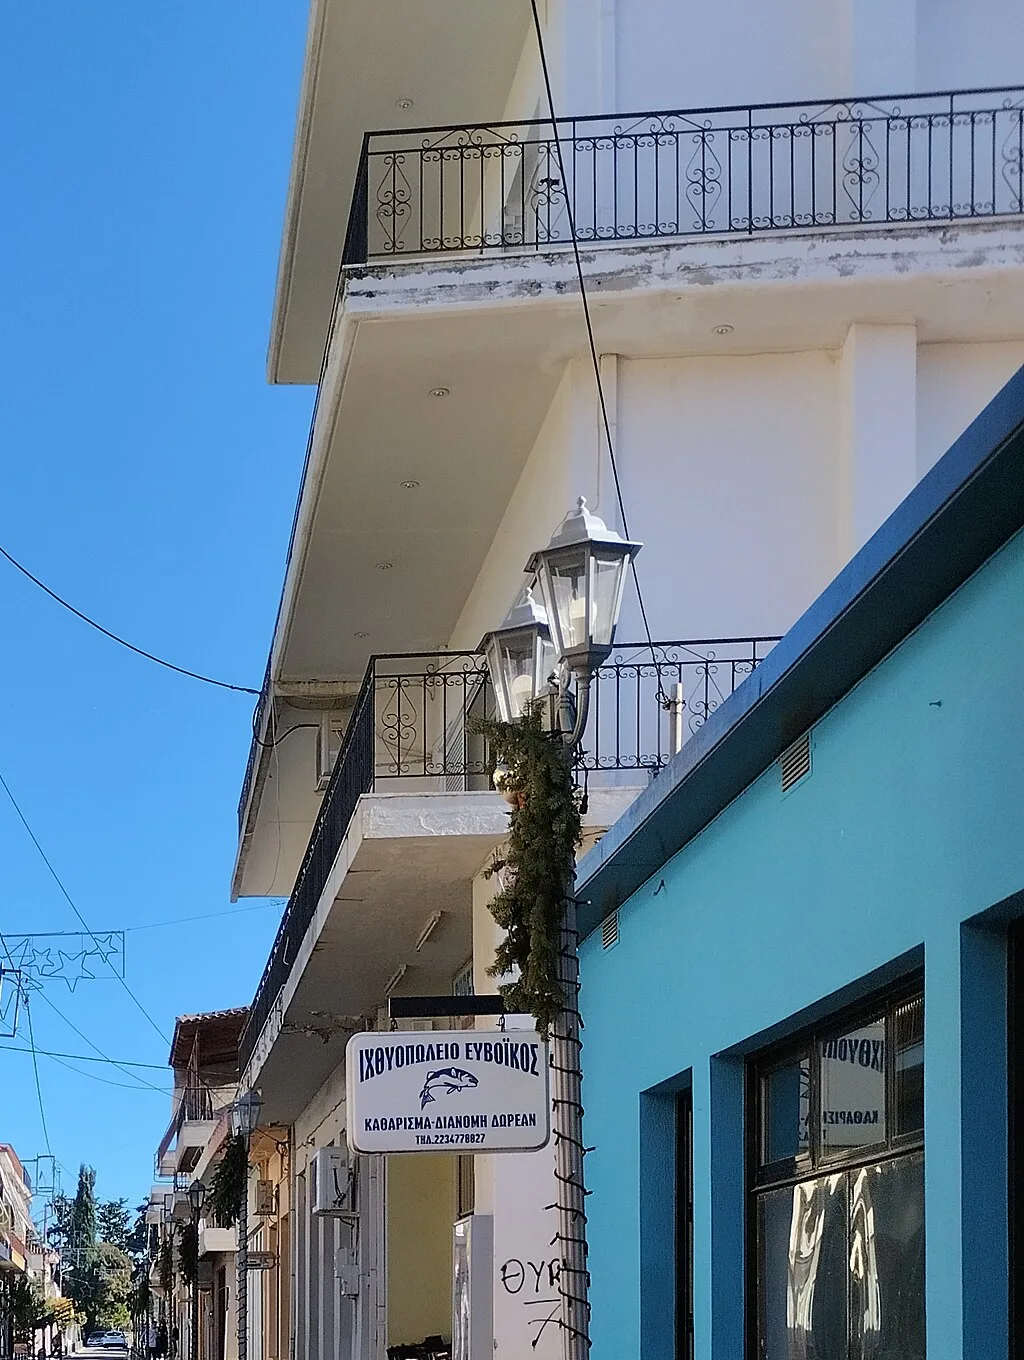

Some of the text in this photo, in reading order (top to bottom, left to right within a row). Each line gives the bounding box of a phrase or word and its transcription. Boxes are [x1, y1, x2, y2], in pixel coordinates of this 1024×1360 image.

[360, 1038, 539, 1083] ΙΧΘΥΟΠΩΛΕΙΟ ΕΥΒΟΪΚΟΣ
[491, 1113, 537, 1128] ΔΩΡΕΑΝ
